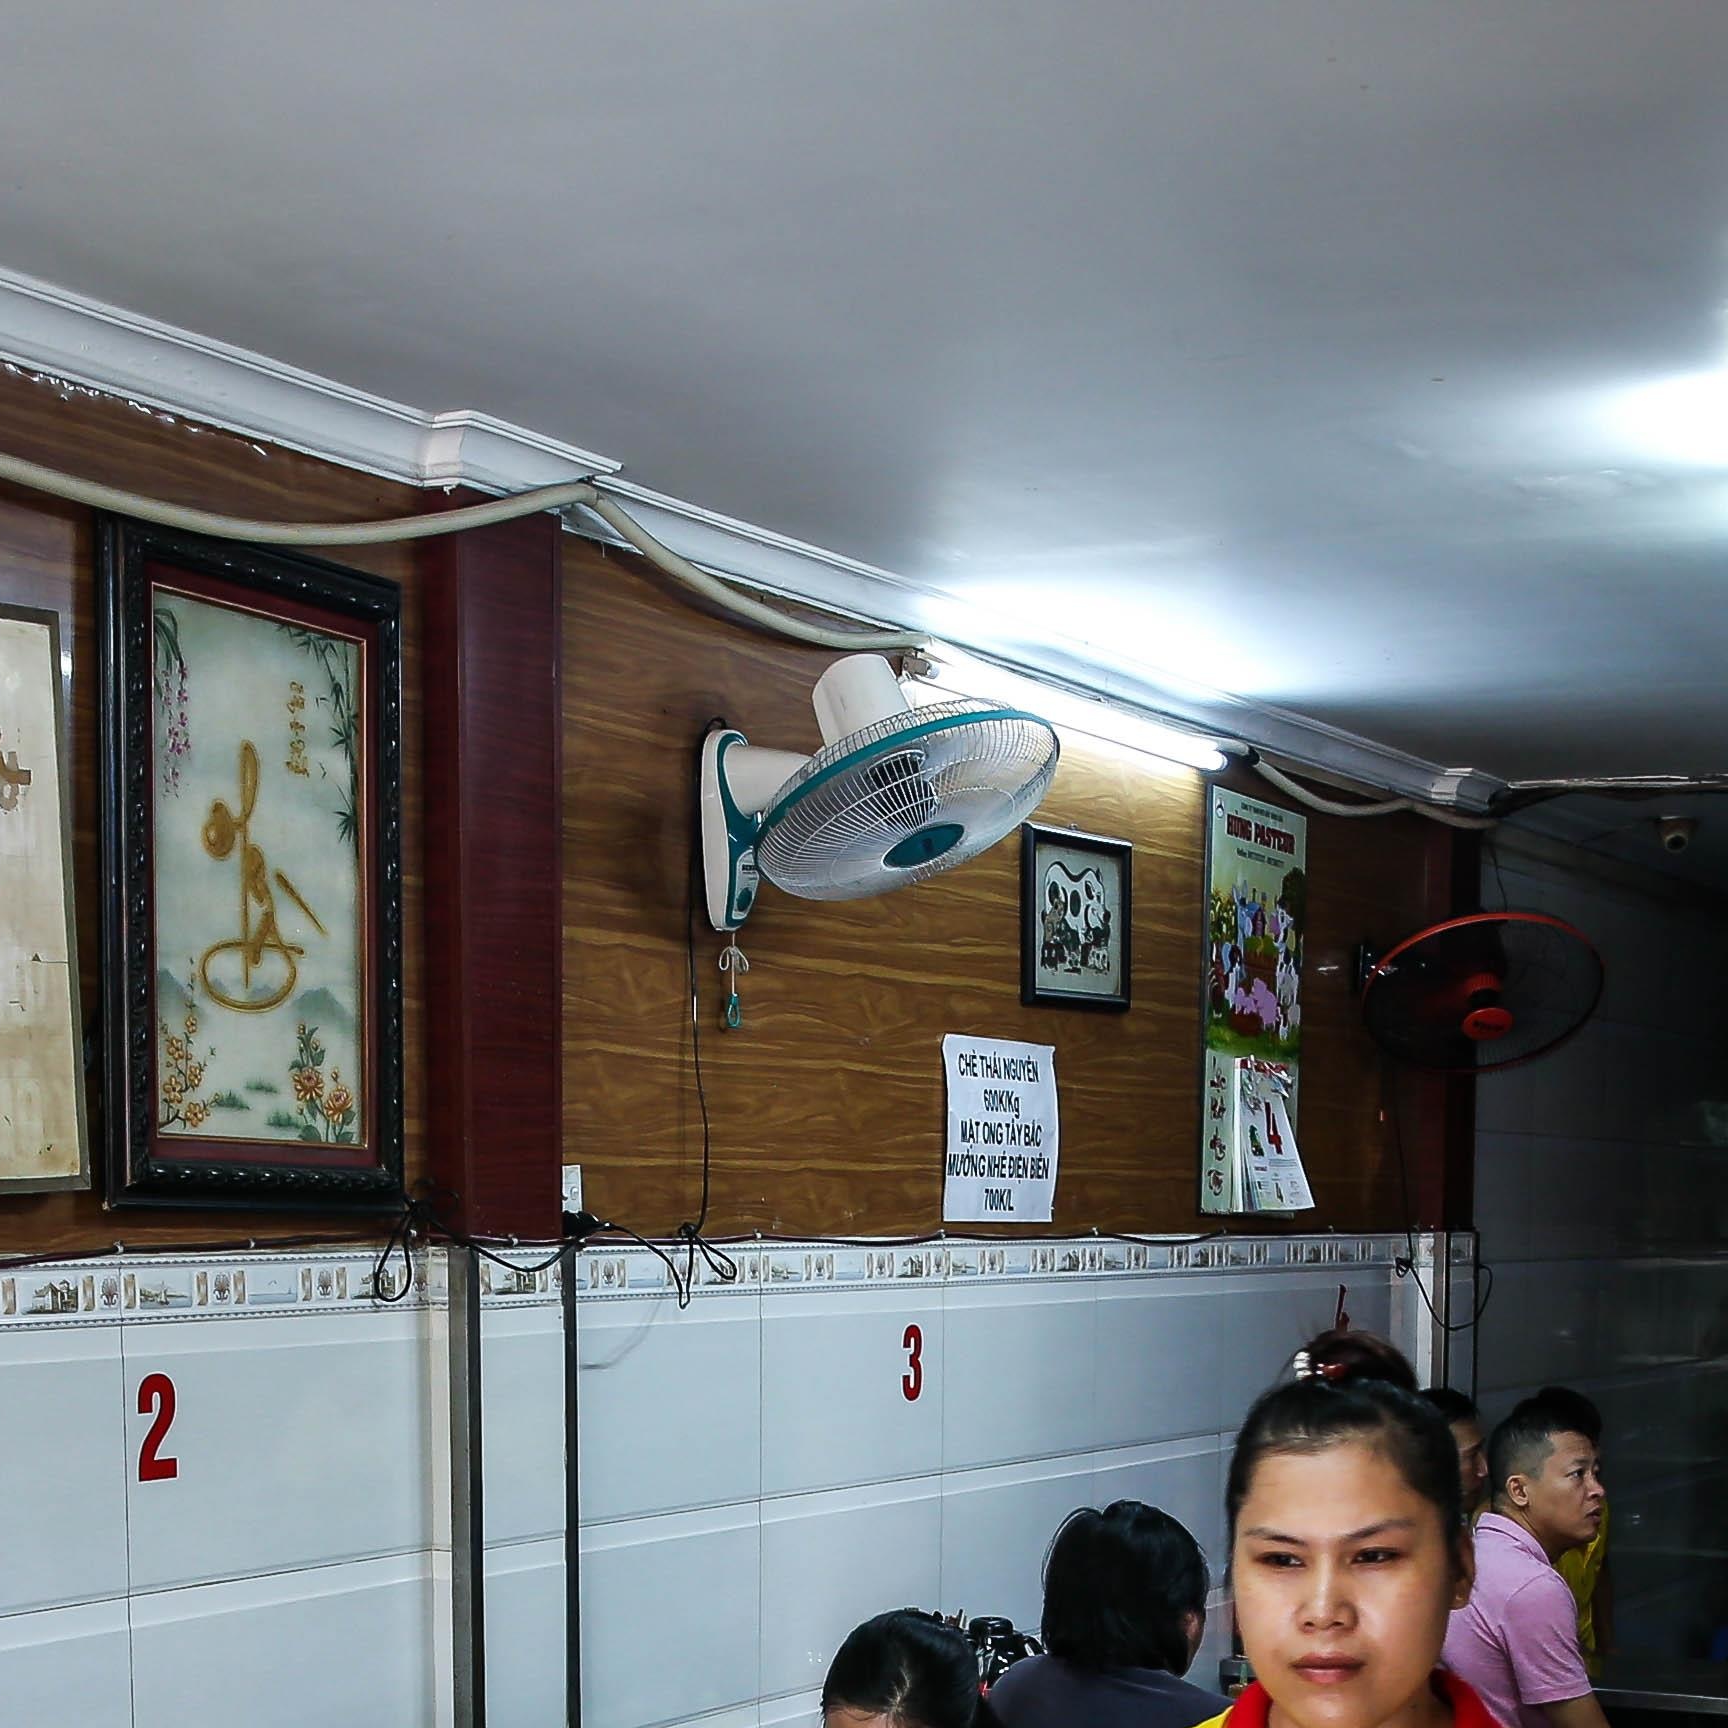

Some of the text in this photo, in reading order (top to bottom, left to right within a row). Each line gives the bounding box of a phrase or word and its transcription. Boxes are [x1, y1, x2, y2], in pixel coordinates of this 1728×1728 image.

[983, 1088, 1020, 1119] 600K/Kg
[982, 1121, 1004, 1145] ONG
[1263, 1101, 1283, 1156] 4
[984, 1188, 1014, 1212] 700K/L
[901, 1323, 923, 1402] 3
[137, 1372, 178, 1482] 2
